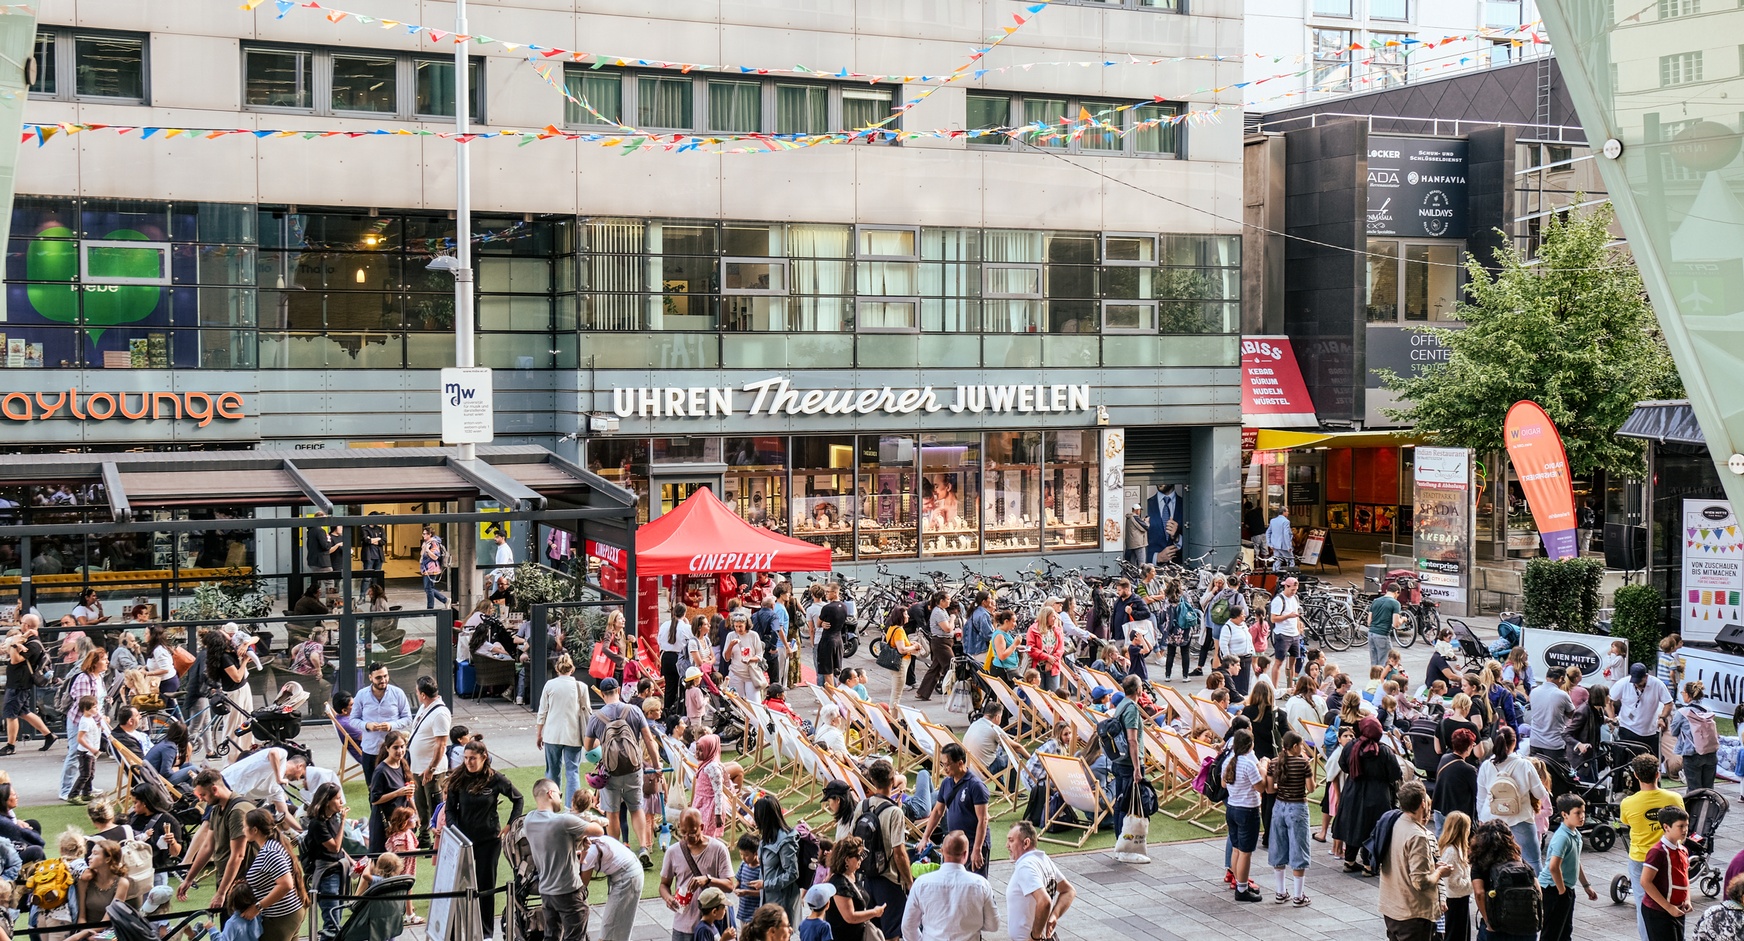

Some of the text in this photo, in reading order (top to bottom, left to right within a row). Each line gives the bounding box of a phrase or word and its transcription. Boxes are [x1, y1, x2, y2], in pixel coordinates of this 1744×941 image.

[1421, 175, 1465, 184] HANFAVIA
[1419, 208, 1453, 217] NAILDAYS
[1410, 335, 1444, 346] OFFIC
[1410, 350, 1450, 360] CENTE
[613, 376, 1090, 417] UHREN Theuerer JUWELEN
[1253, 397, 1290, 405] WÜRSTEL
[1, 387, 245, 428] aylounge
[1420, 503, 1459, 516] SPADA
[1427, 533, 1459, 543] KEBAP
[595, 542, 621, 564] CINEPLEXX
[689, 550, 779, 571] CINEPLEXX
[1421, 561, 1458, 569] enterprise
[1549, 652, 1596, 664] WIEN MITTE
[1649, 823, 1661, 831] Tea
